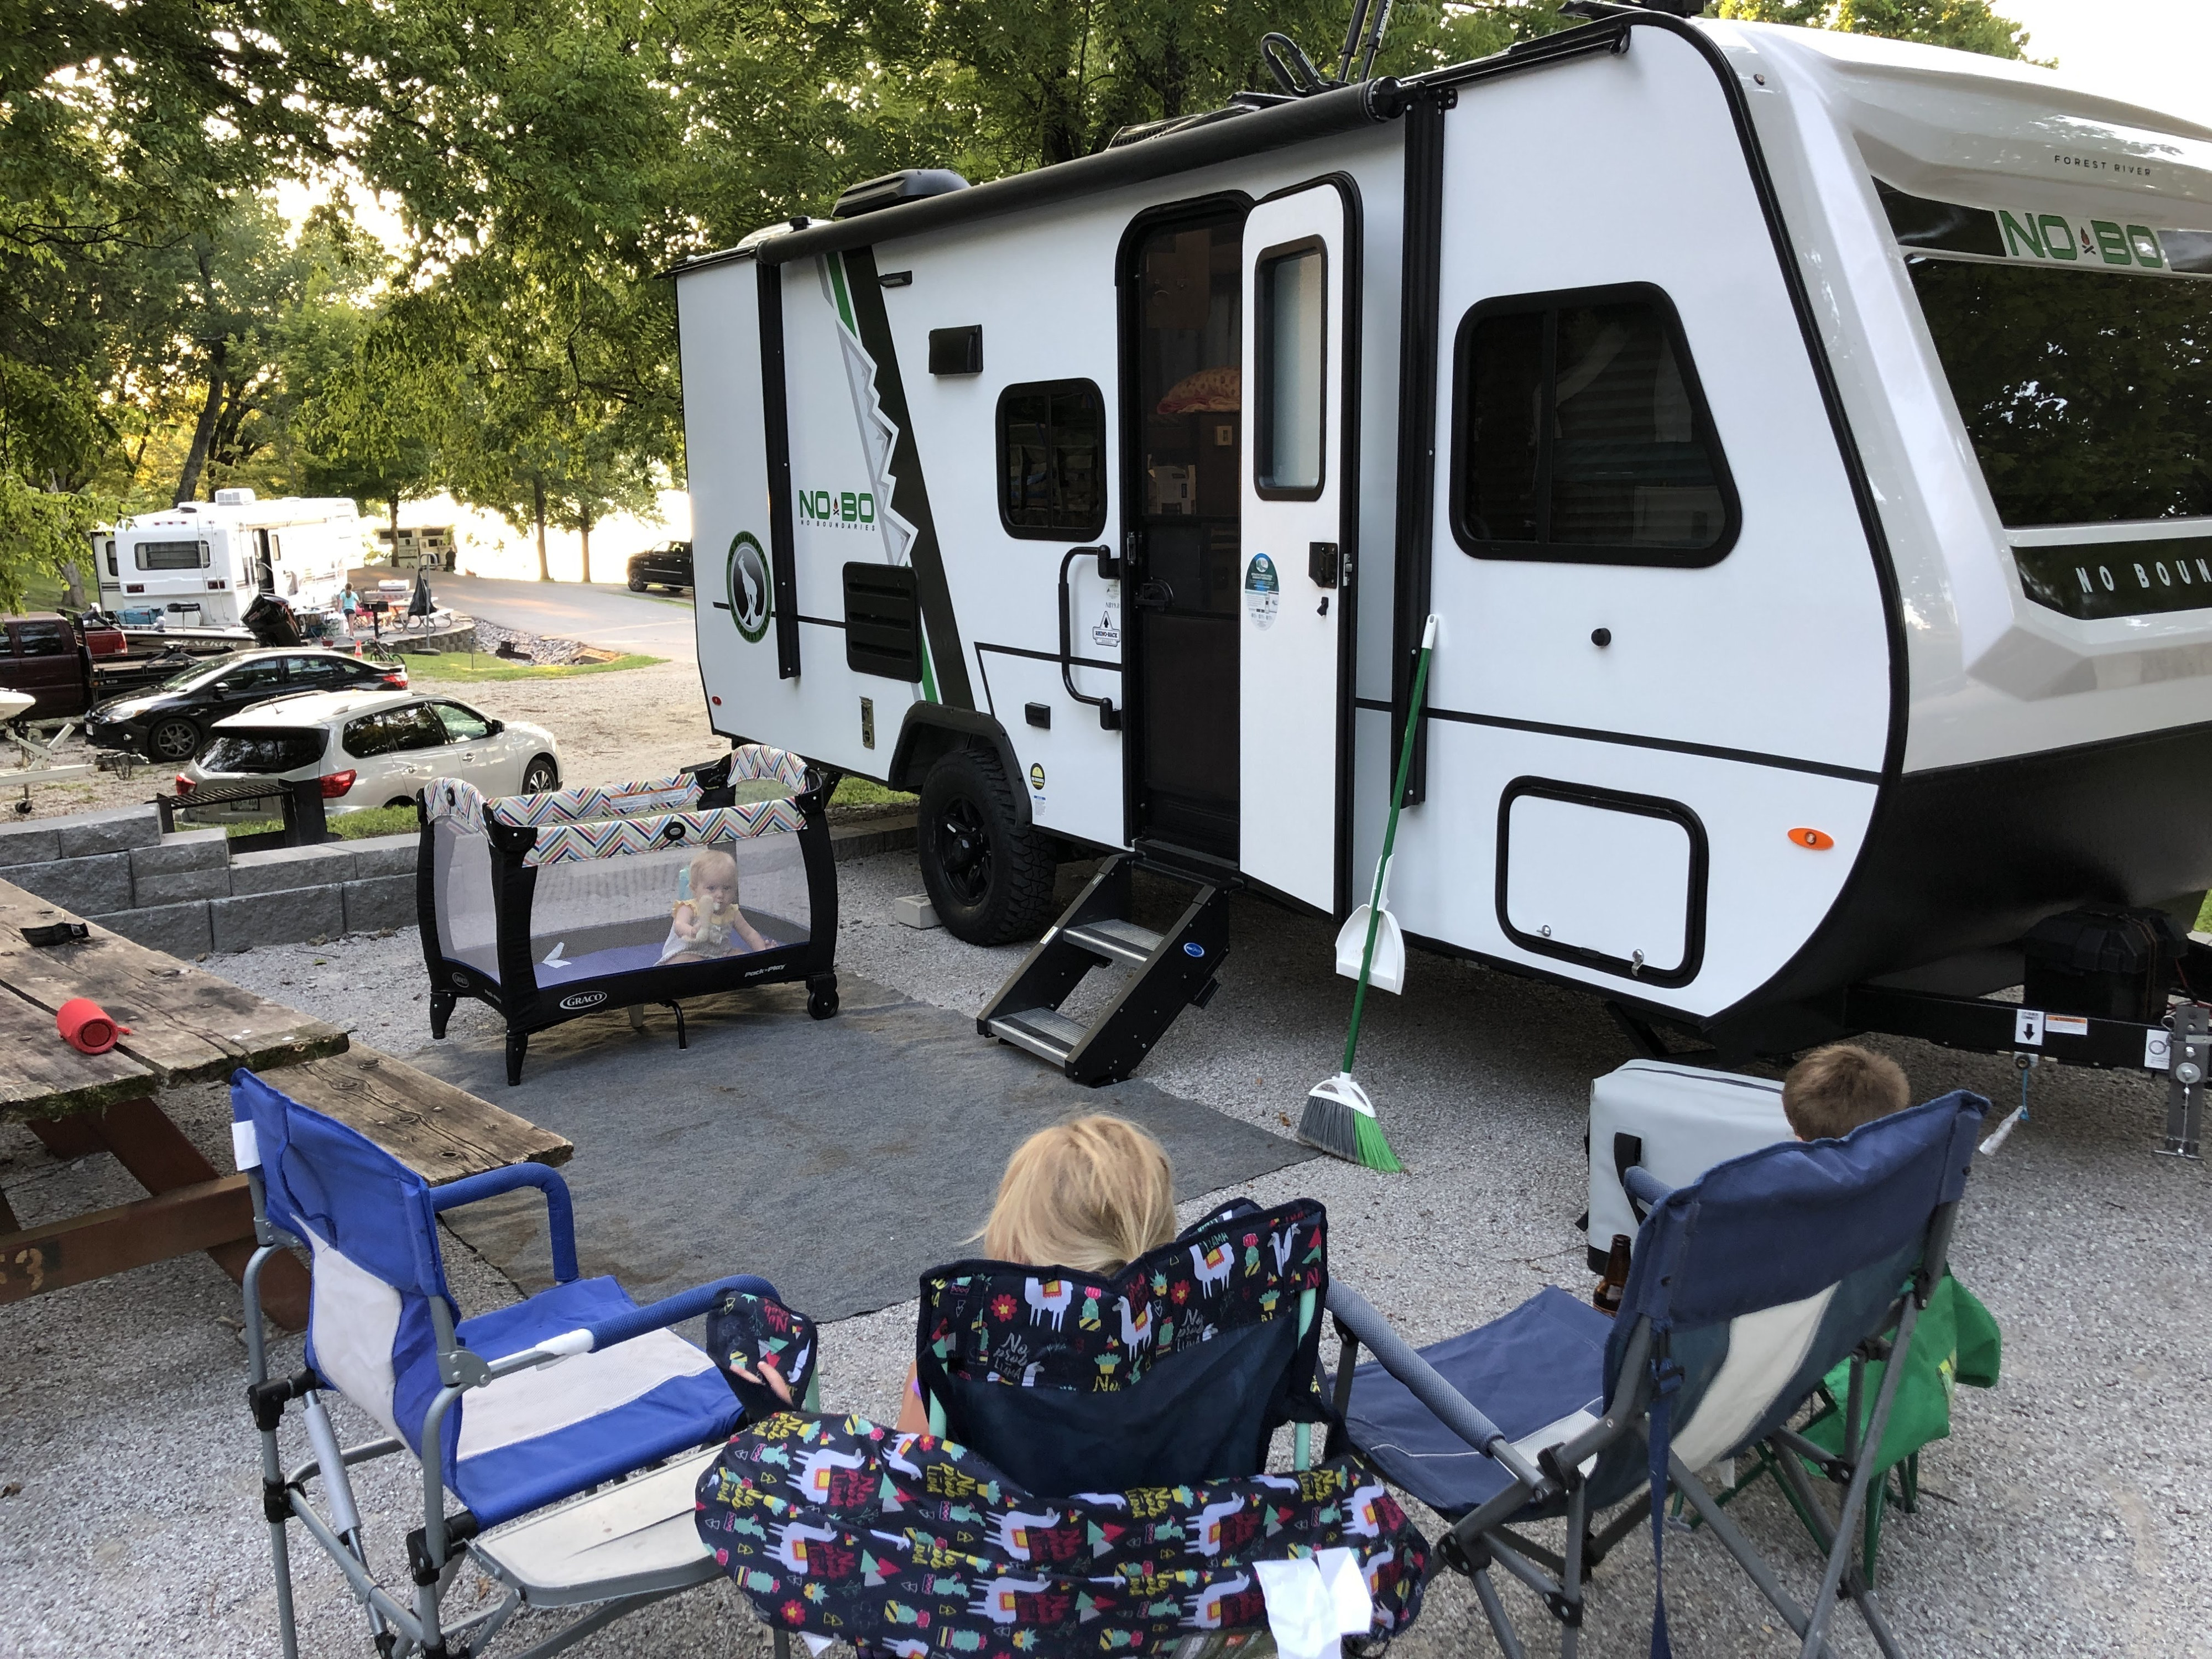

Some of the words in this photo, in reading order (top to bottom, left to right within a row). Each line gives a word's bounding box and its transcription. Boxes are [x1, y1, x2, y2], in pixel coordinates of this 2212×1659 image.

[2054, 155, 2106, 169] FOREST
[2114, 164, 2151, 176] RIVER
[1999, 210, 2077, 260] NO
[2090, 220, 2163, 268] BO
[799, 490, 830, 520] NO
[841, 492, 874, 523] BO
[816, 521, 875, 531] BOUNDARIES
[2075, 566, 2115, 593] NO
[2133, 558, 2212, 588] BOUN
[178, 640, 238, 648] RACKER
[567, 993, 603, 1006] GRACO
[1000, 1332, 1027, 1353] No
[957, 1469, 976, 1499] No
